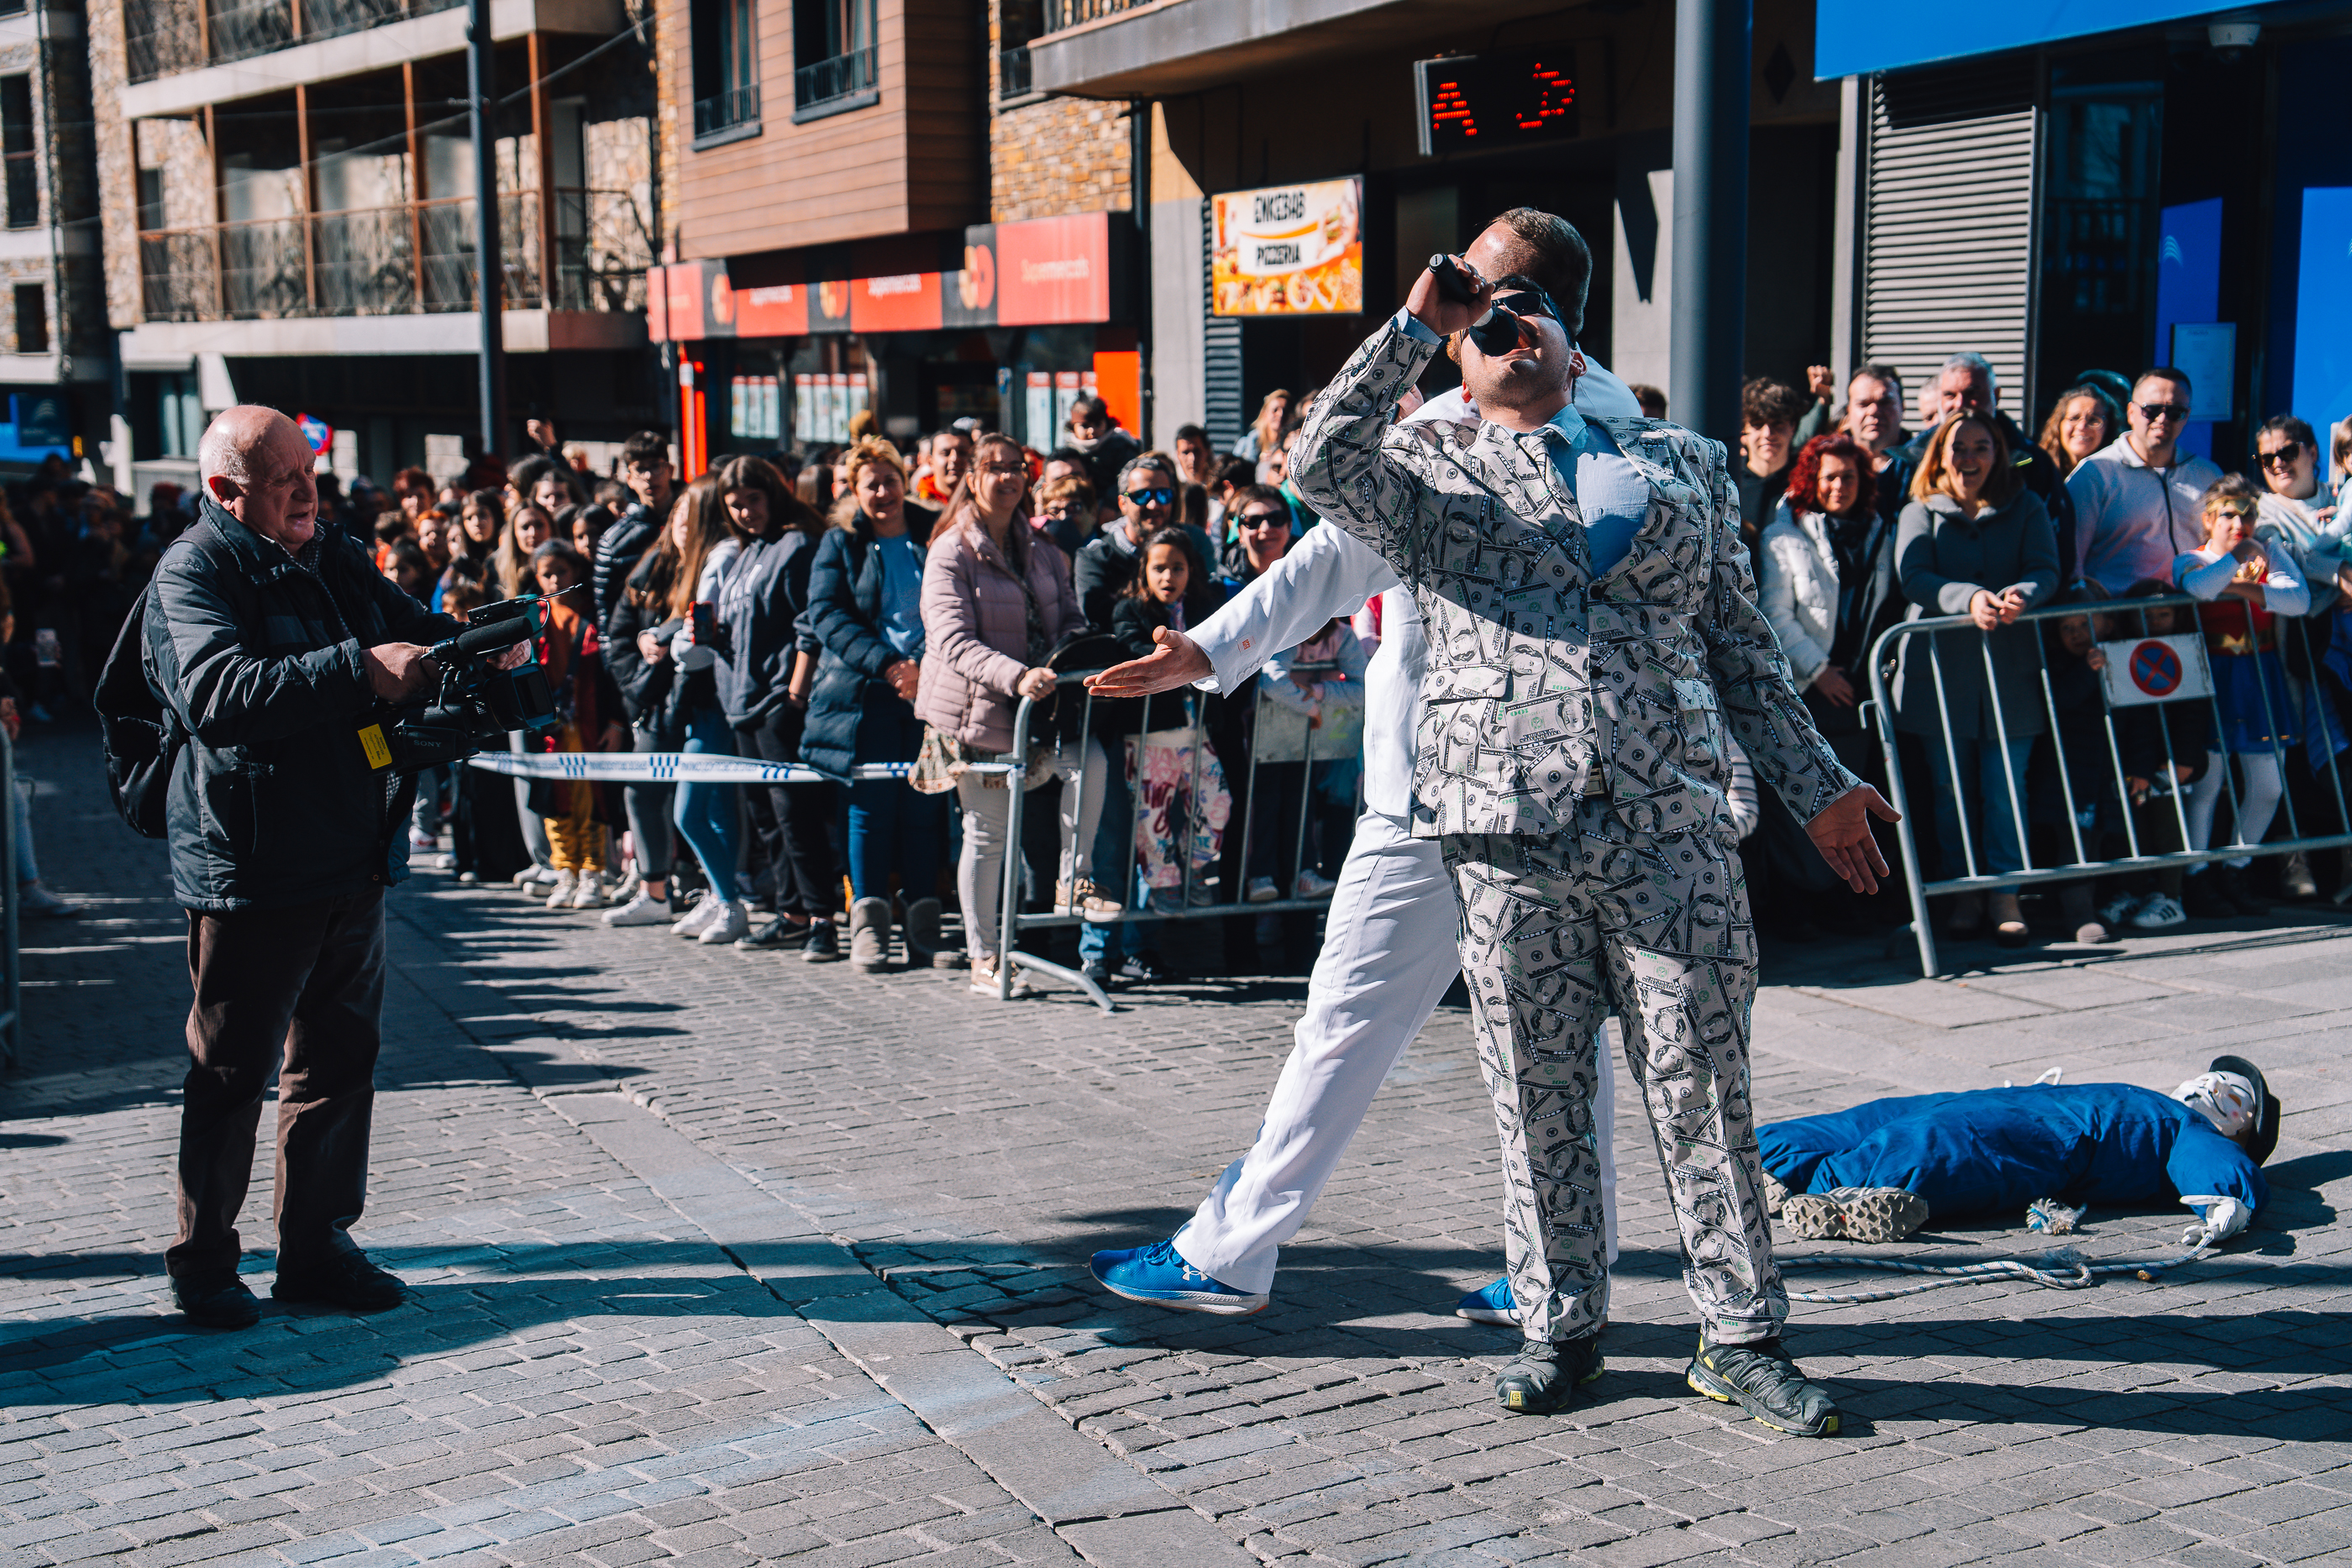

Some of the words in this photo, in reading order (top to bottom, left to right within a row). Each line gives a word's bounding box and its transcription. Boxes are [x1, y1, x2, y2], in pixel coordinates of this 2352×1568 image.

[1257, 243, 1301, 265] PIZZERIA
[1498, 454, 1513, 473] 100
[1517, 536, 1544, 545] 100
[1534, 543, 1551, 564] 100
[1661, 548, 1674, 564] 100
[1456, 585, 1464, 602] 100
[1508, 594, 1527, 602] 100
[1552, 655, 1572, 670] 100
[1597, 648, 1615, 668] 100
[1646, 663, 1664, 674] 100
[1622, 682, 1635, 699] 100
[1636, 694, 1659, 707] 100
[1772, 704, 1784, 721] 100
[1766, 720, 1779, 744] 100
[413, 739, 443, 747] SONY
[1516, 742, 1545, 750] 100
[1530, 748, 1551, 769] 100
[1619, 762, 1639, 776] 100
[1470, 781, 1486, 789] 100
[1556, 781, 1572, 799] 100
[1502, 797, 1520, 805] 100
[1813, 786, 1823, 811] 100
[1585, 831, 1612, 842] 100
[1523, 847, 1531, 873] 100
[1657, 852, 1676, 876] 100
[1466, 868, 1483, 879] 100
[1547, 865, 1572, 877] 100
[1541, 895, 1559, 905] 100
[1641, 913, 1666, 925] 100
[1520, 930, 1546, 941] 100
[1640, 951, 1658, 960] 100
[1531, 966, 1553, 975] 100
[1708, 968, 1717, 986] 100
[1637, 982, 1662, 993] 100
[1674, 981, 1688, 1007] 100
[1556, 1011, 1577, 1021] 100
[1528, 1039, 1539, 1063] 100
[1501, 1052, 1509, 1069] 100
[1705, 1051, 1719, 1076] 100
[1536, 1109, 1561, 1120] 100
[1681, 1106, 1706, 1117] 100
[1546, 1140, 1567, 1150] 100
[1672, 1170, 1700, 1180] 100
[1571, 1183, 1590, 1194] 100
[1682, 1207, 1703, 1223] 100
[1546, 1216, 1556, 1237] 100
[1569, 1255, 1588, 1263] 100
[1725, 1289, 1748, 1303] 100
